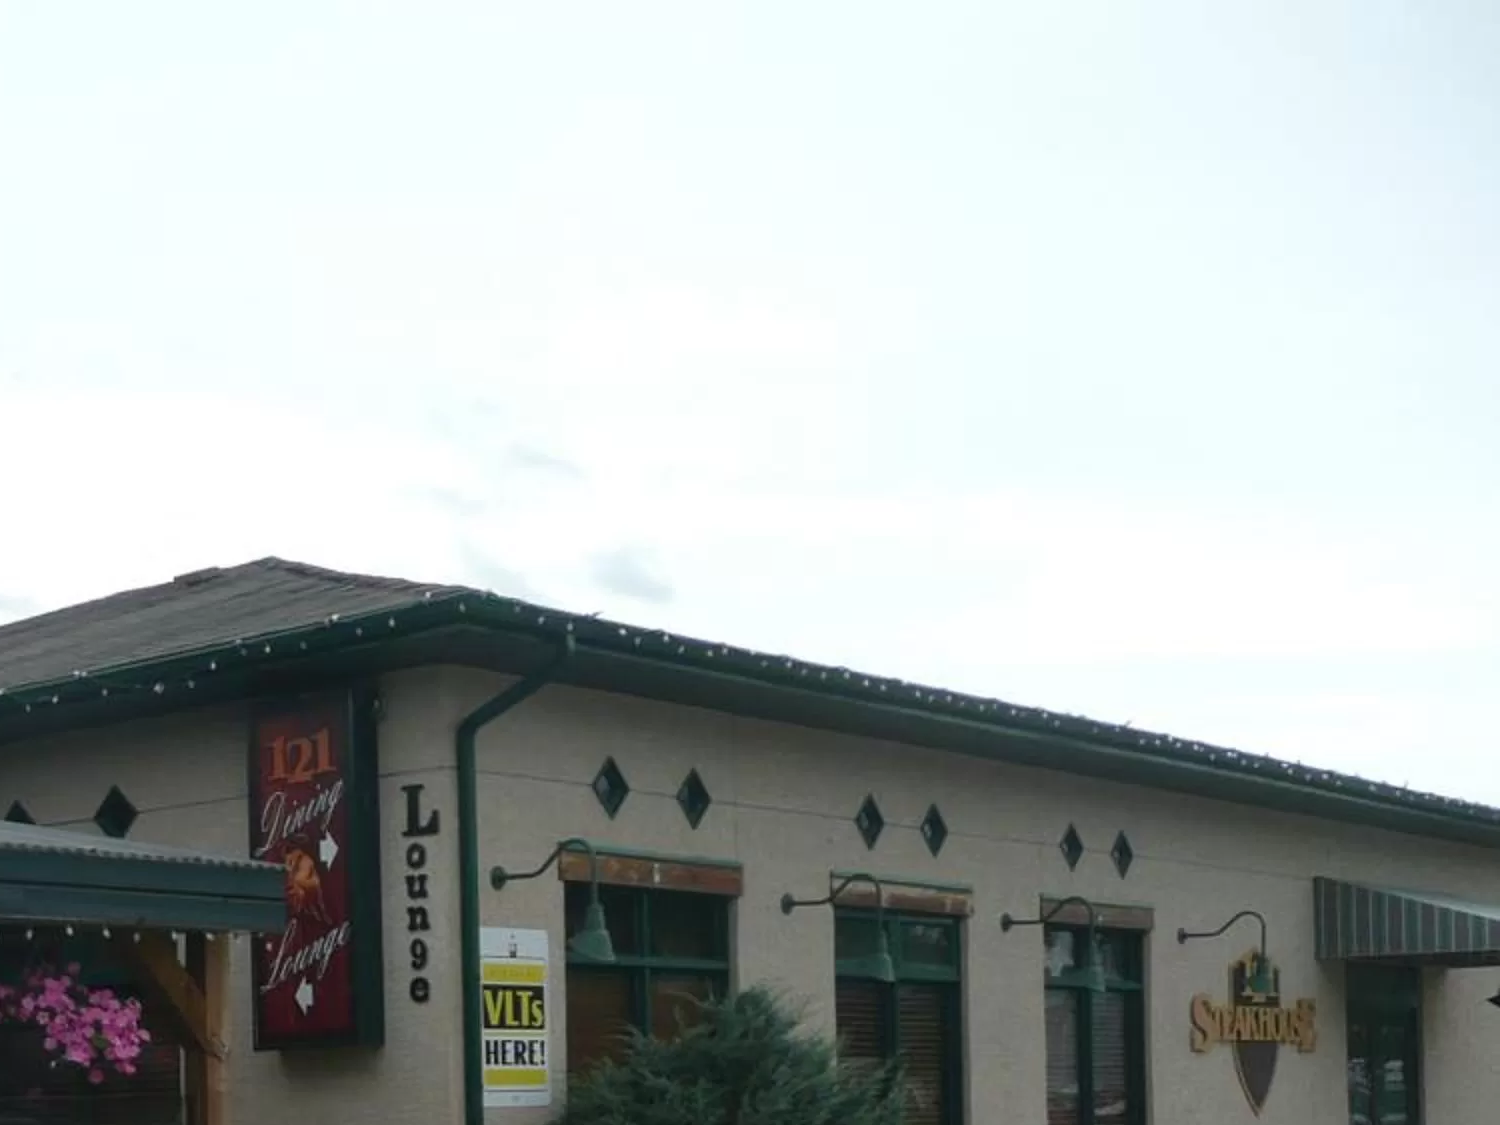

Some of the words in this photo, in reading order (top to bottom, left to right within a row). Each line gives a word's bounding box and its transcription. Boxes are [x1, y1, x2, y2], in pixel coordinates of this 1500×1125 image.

[267, 727, 337, 783] 121
[254, 779, 342, 857] Dining
[401, 784, 441, 1004] Lounge
[260, 918, 350, 994] Lounge
[483, 989, 544, 1027] VLTs
[485, 1040, 546, 1066] HERE!
